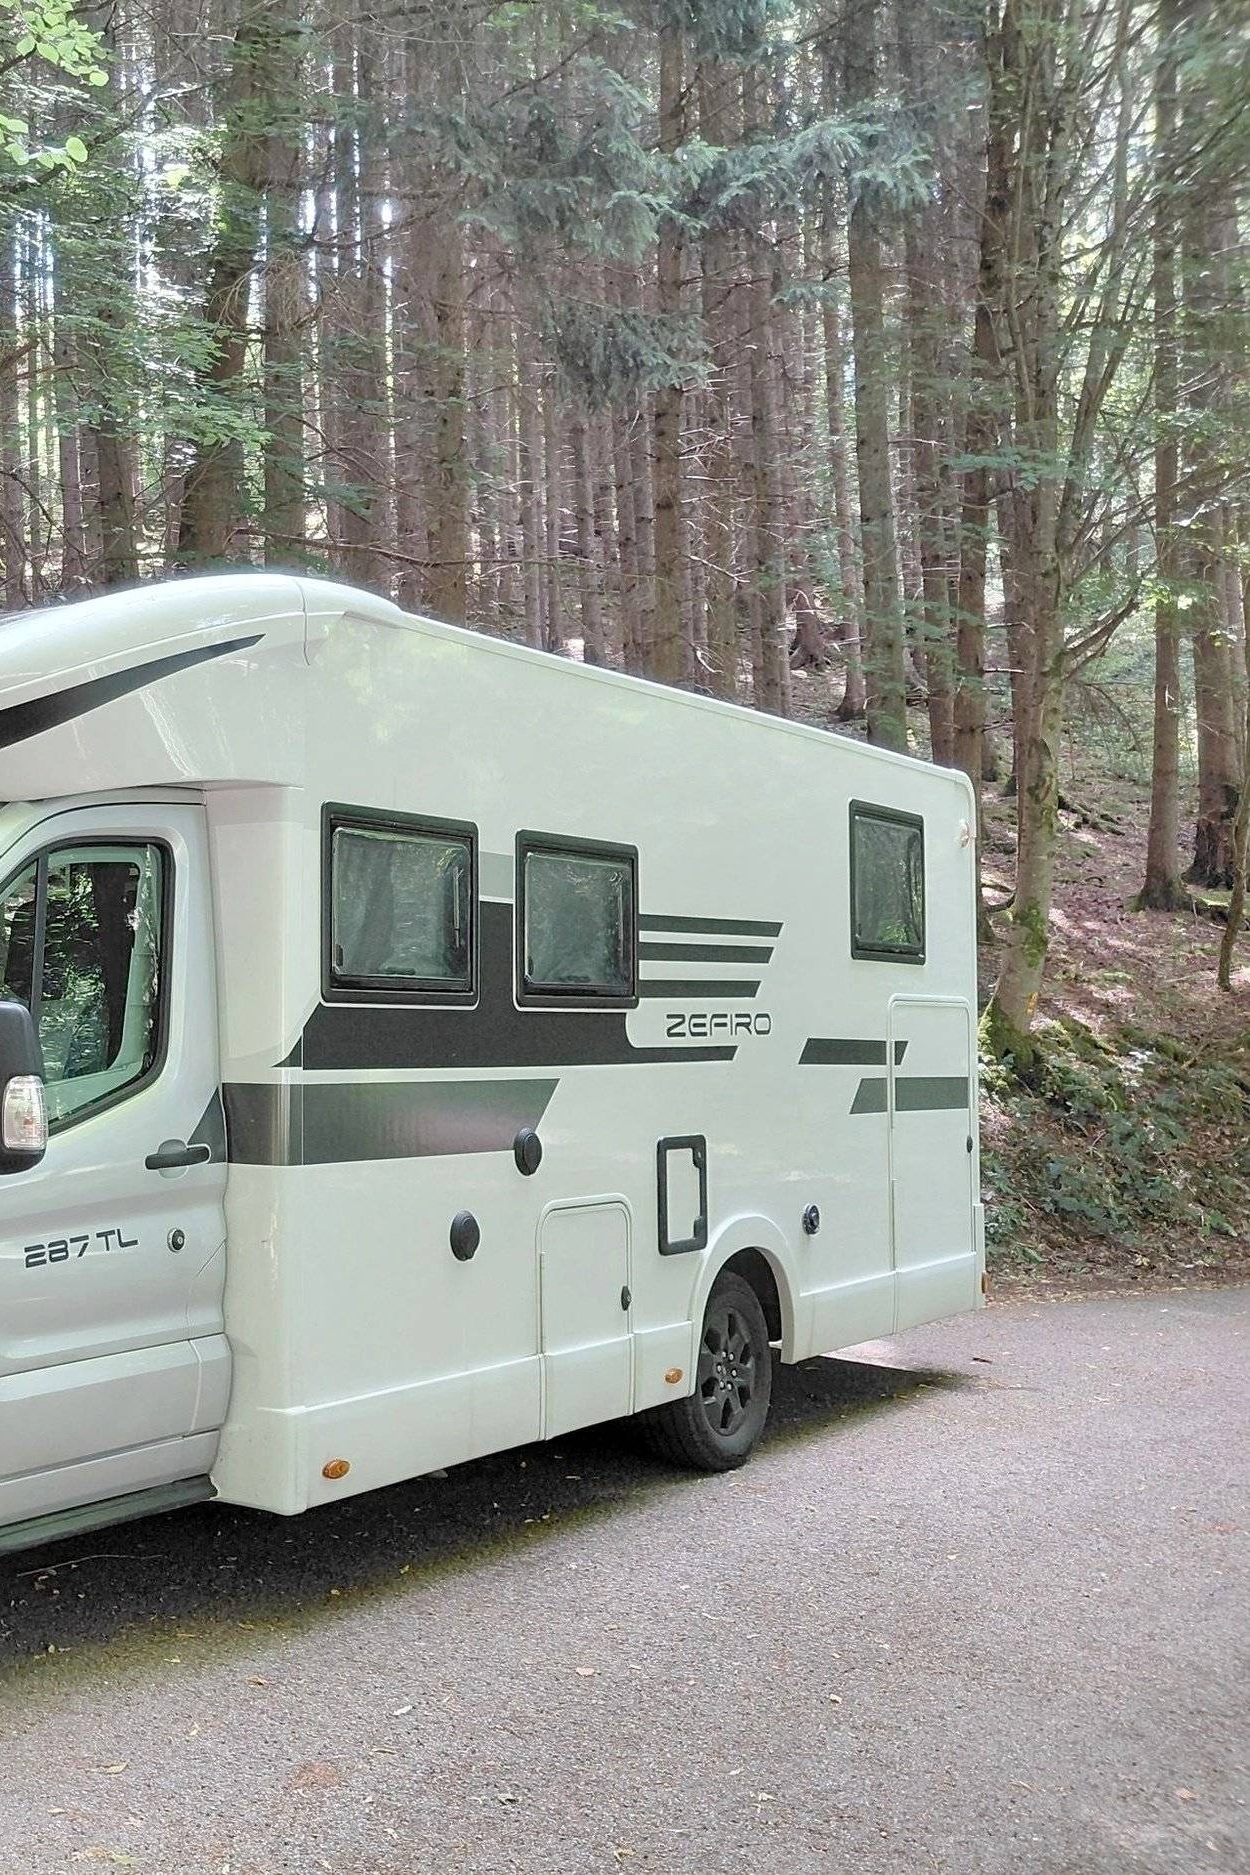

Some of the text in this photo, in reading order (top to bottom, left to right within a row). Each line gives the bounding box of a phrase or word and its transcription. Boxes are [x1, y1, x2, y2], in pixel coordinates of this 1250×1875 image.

[666, 1013, 772, 1037] ZEFIRO
[24, 1228, 139, 1269] 287 TL
